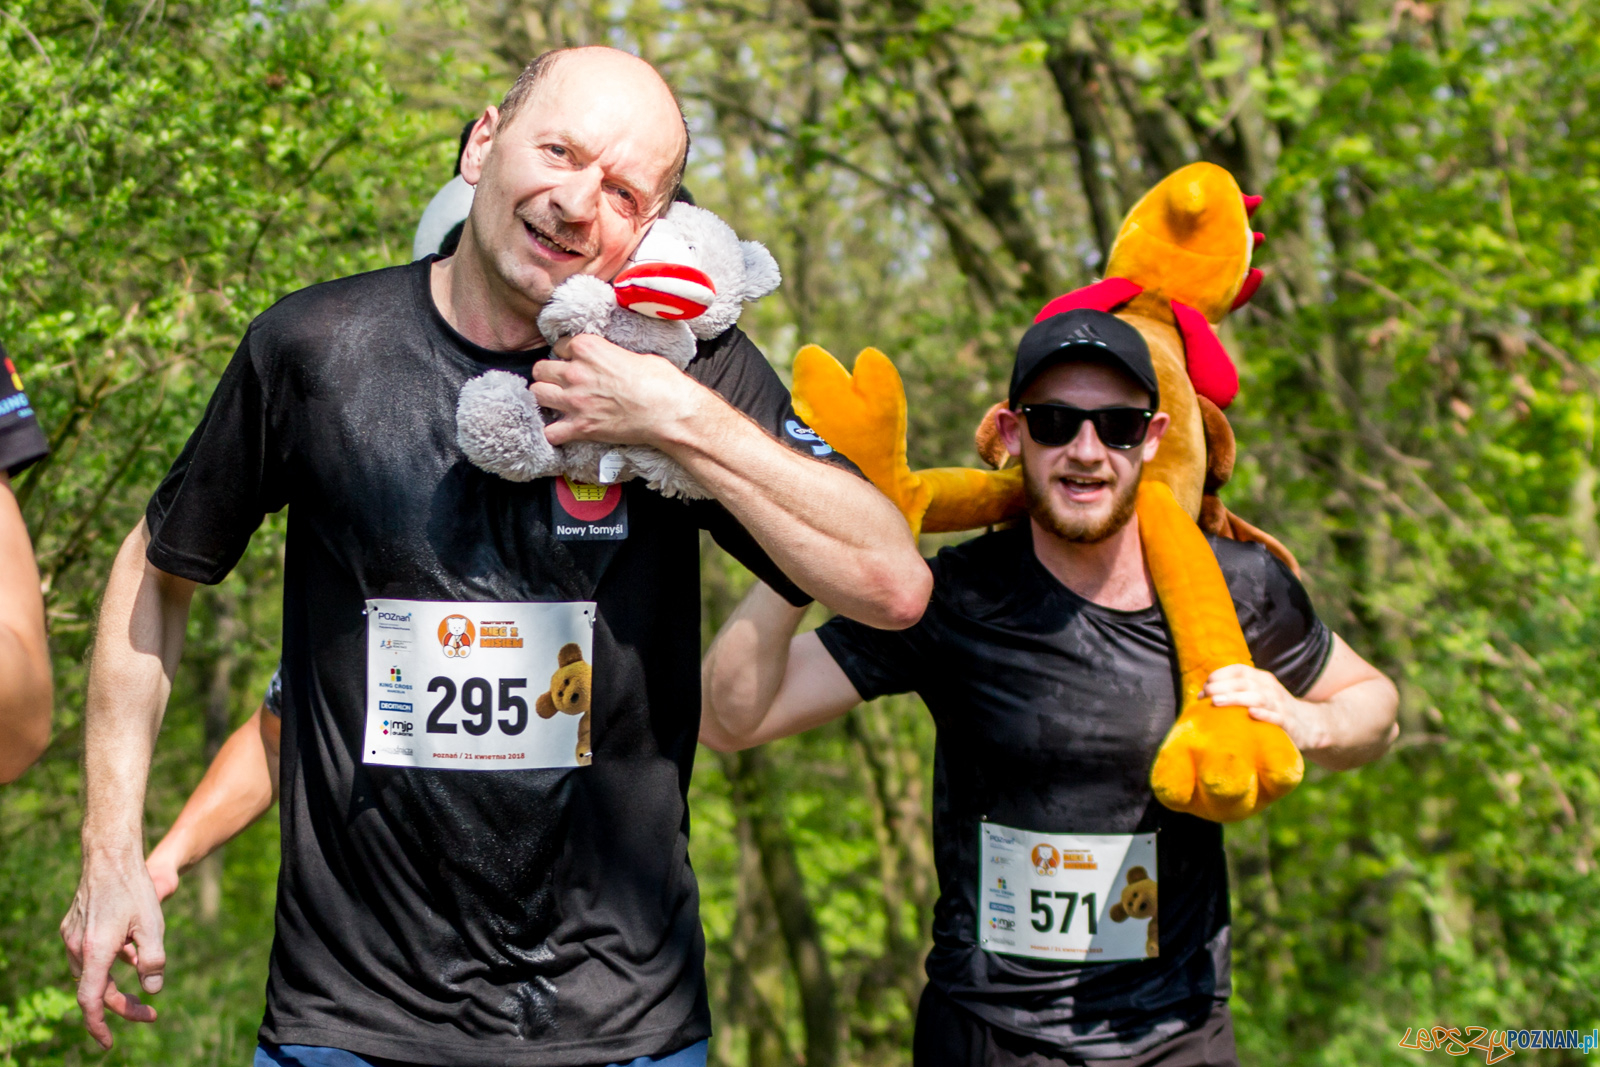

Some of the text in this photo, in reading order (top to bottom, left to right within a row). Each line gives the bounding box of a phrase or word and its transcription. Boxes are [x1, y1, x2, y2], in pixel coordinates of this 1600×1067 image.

[556, 523, 624, 537] Nowy Tomyśl
[380, 702, 412, 711] DECATHLON
[426, 676, 528, 736] 295
[392, 721, 413, 732] mjp
[1030, 889, 1098, 935] 571
